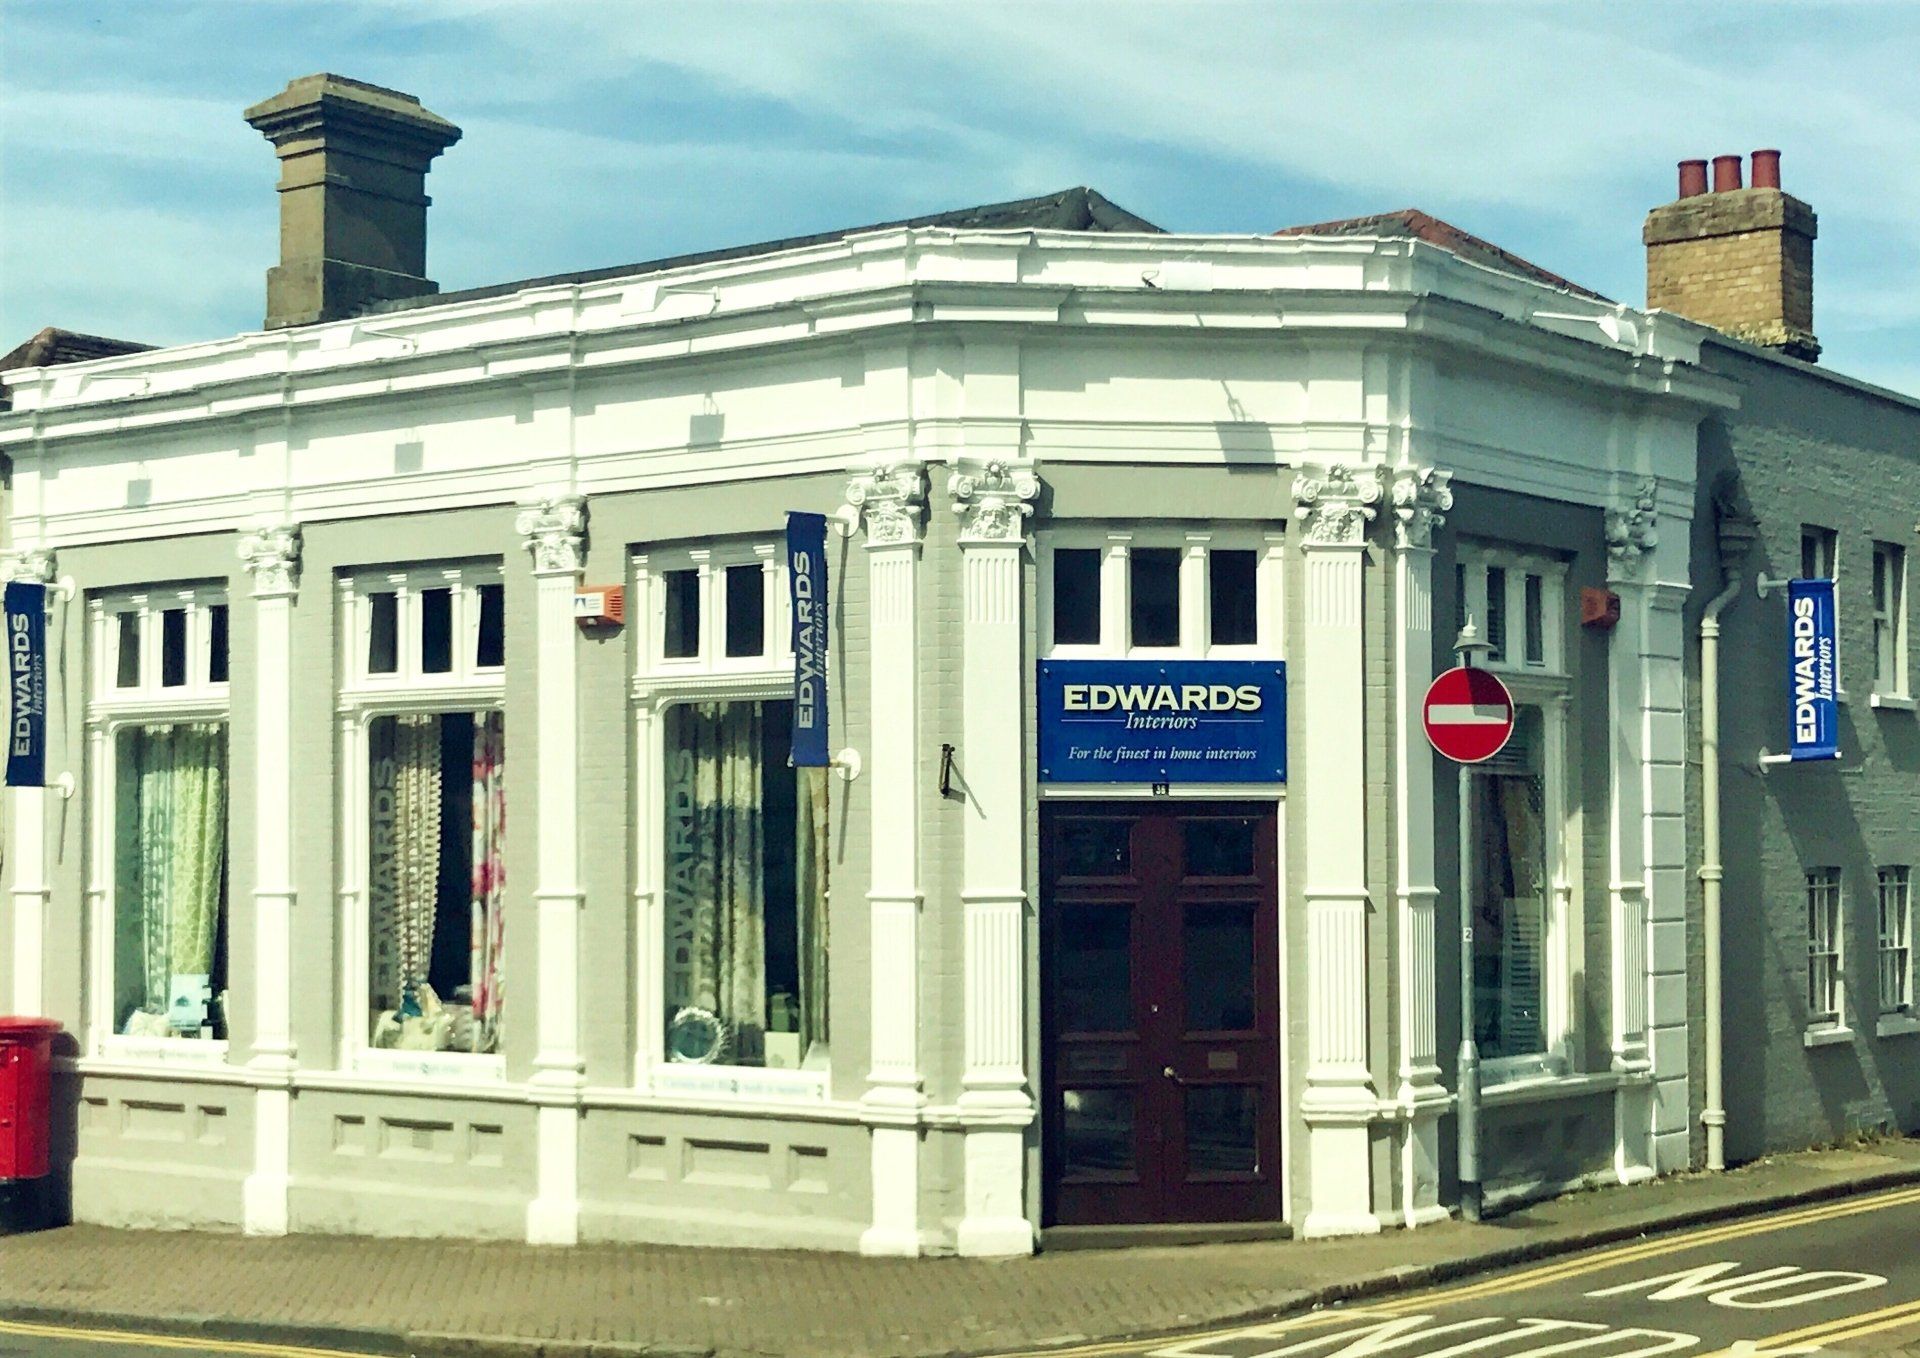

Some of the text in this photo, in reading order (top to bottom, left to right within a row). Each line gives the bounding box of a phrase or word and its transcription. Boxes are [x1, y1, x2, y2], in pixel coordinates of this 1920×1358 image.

[794, 550, 814, 729] EDWARDS
[814, 601, 826, 678] Interiors
[1794, 597, 1815, 743] EDWARDS
[1815, 637, 1832, 701] Interiors
[13, 613, 31, 757] EDWARDS
[31, 653, 43, 716] Interiors
[1063, 684, 1262, 711] EDWARDS
[1125, 712, 1198, 730] Interiors
[1068, 746, 1257, 763] For the finest in home interiors
[668, 748, 694, 1000] EDWARDS
[1465, 929, 1471, 940] 2
[1584, 1261, 1888, 1309] NO
